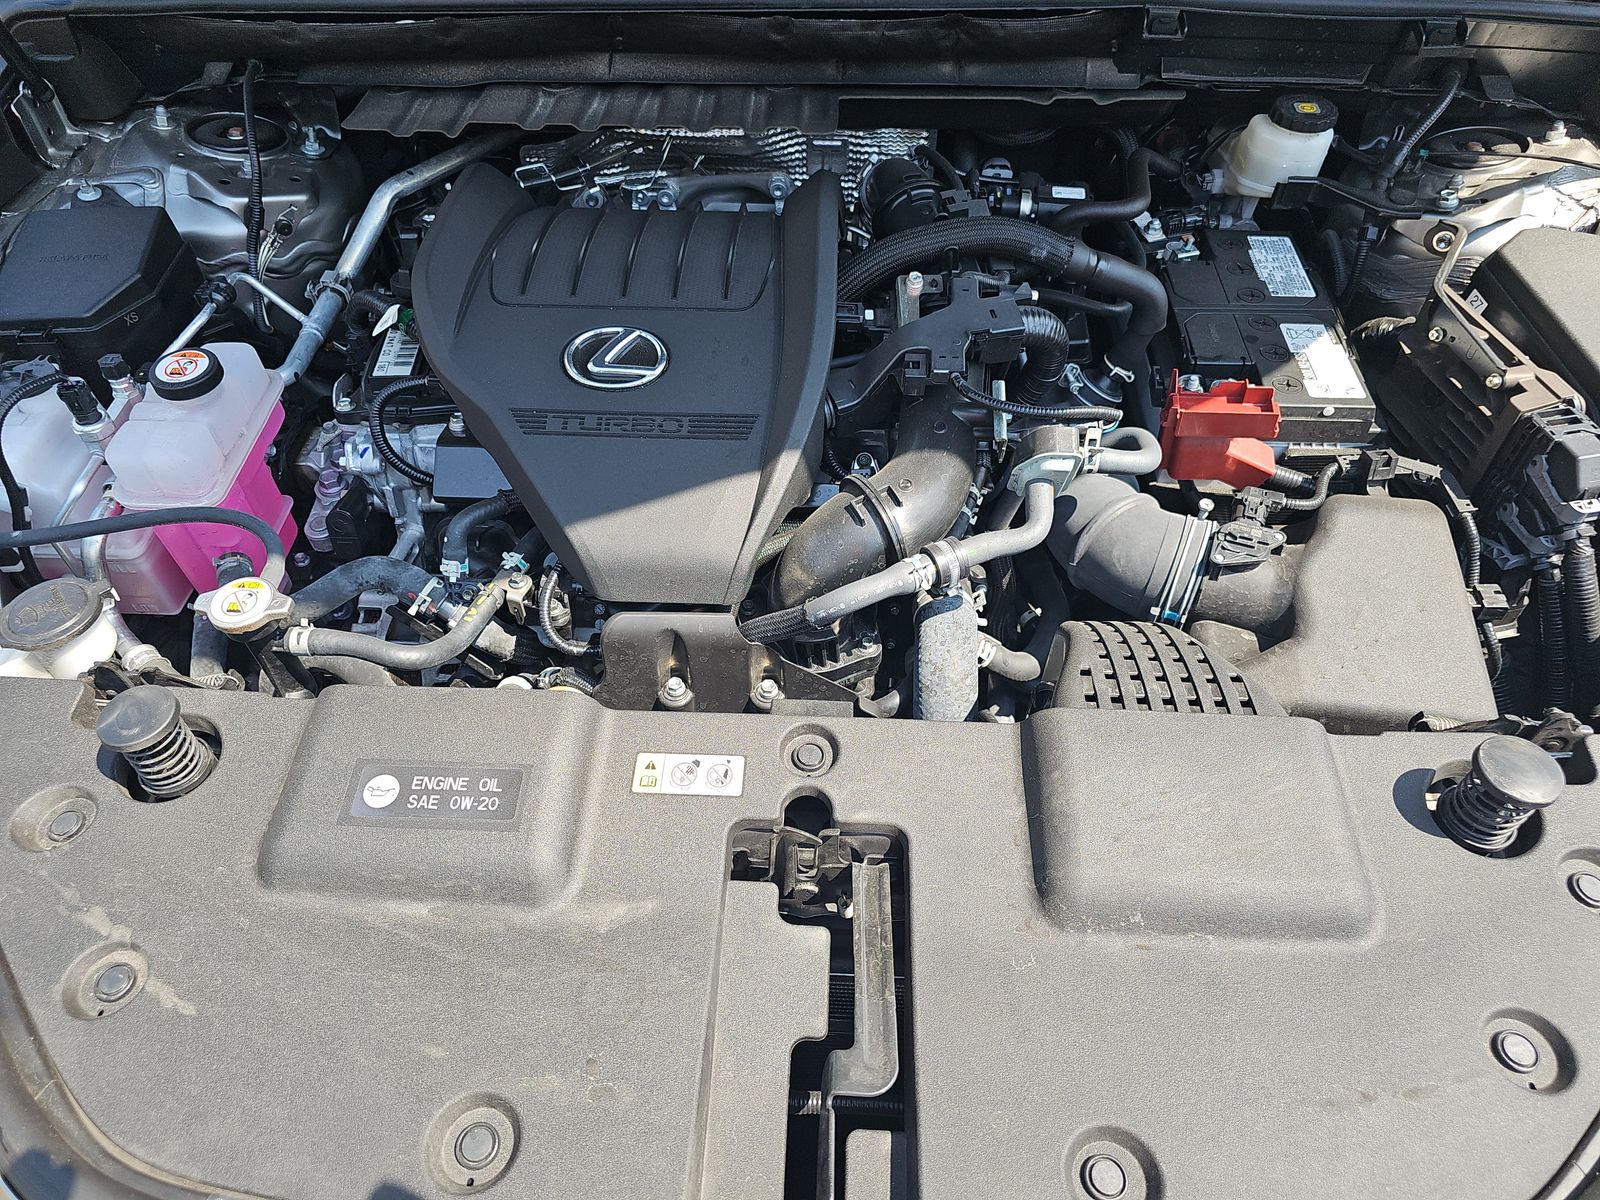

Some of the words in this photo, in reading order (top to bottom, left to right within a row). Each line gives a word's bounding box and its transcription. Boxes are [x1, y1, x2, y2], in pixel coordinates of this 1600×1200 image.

[1469, 295, 1484, 310] 27
[123, 311, 139, 326] XS
[551, 415, 684, 433] TURBO
[411, 776, 470, 791] ENGINE
[478, 778, 502, 792] OIL
[407, 794, 440, 809] SAE
[450, 796, 499, 811] 0W-20
